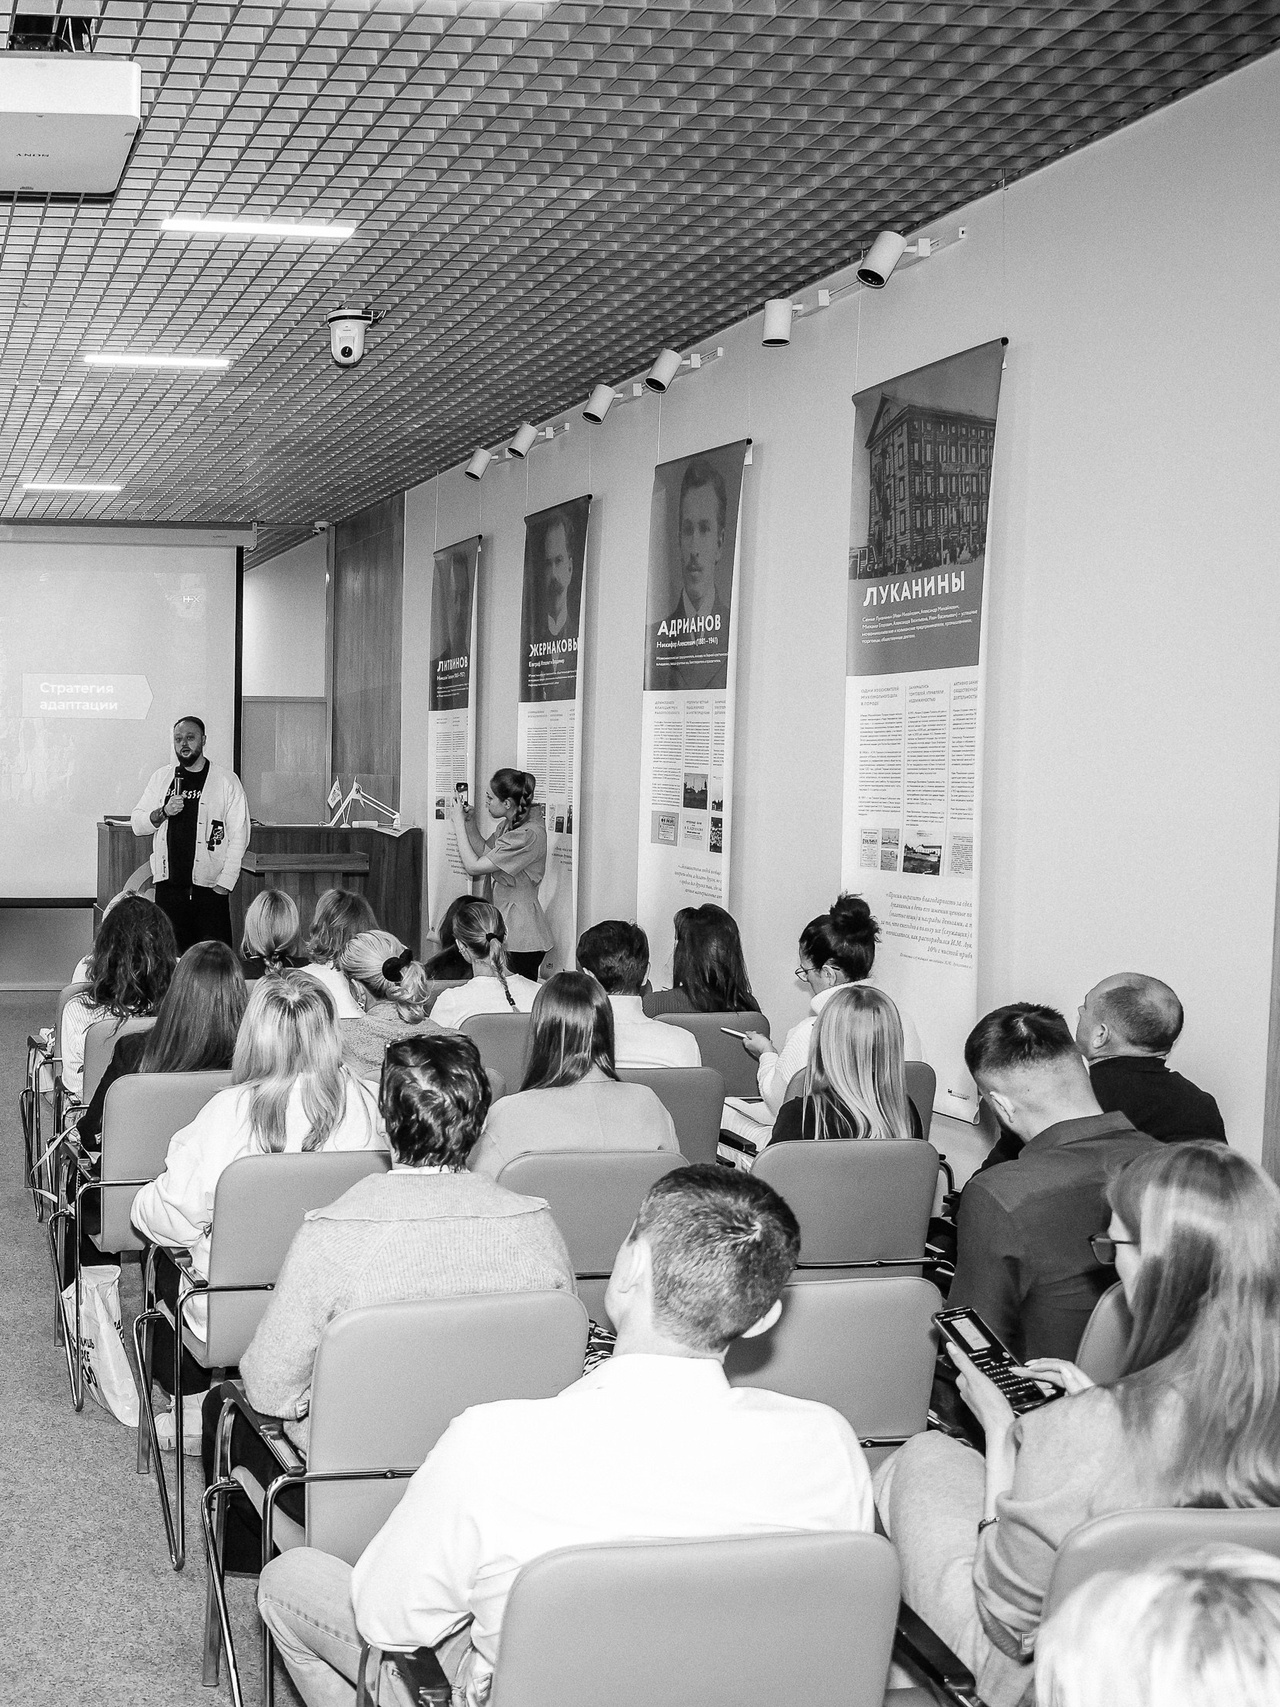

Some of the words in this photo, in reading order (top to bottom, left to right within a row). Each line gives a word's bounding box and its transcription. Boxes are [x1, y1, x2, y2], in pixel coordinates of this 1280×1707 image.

[863, 570, 965, 607] ЛУКАНИНЫ
[657, 614, 721, 637] АДРИАНОВ
[39, 682, 114, 695] Стратегия
[39, 701, 118, 712] адаптации
